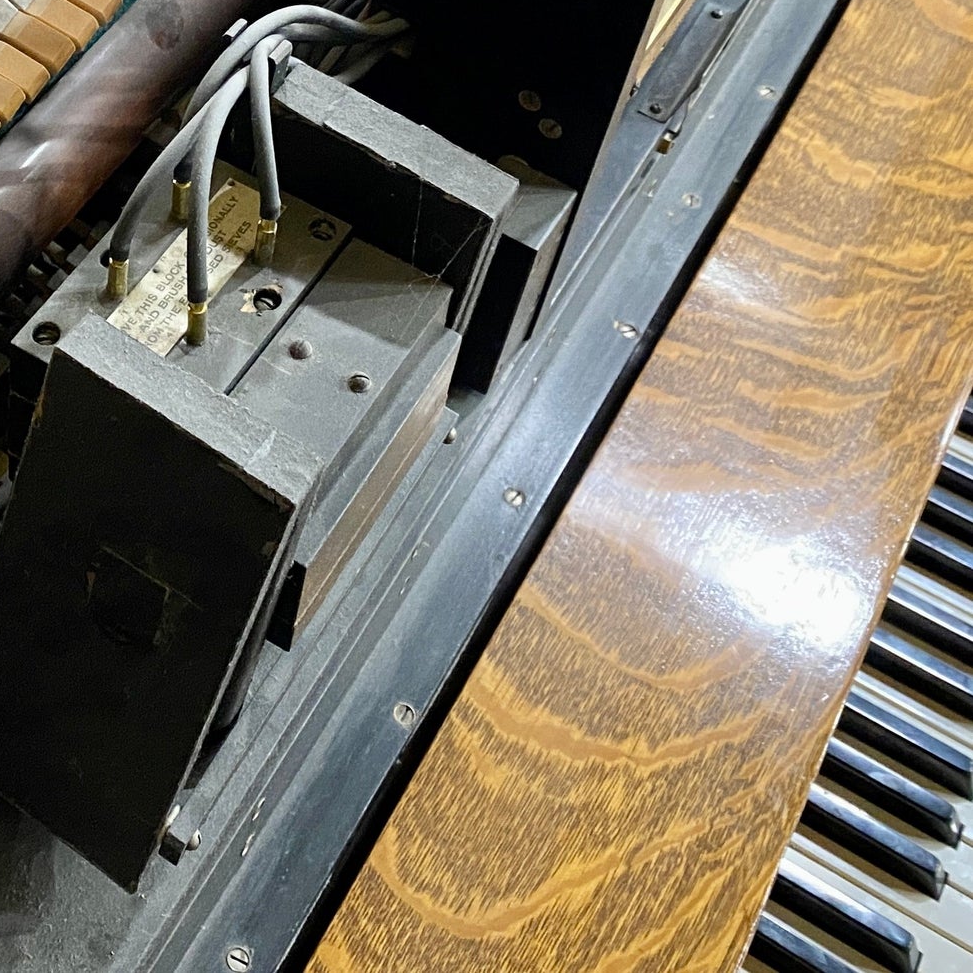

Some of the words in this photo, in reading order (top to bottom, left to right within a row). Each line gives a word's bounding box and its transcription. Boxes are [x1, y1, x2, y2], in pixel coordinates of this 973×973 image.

[135, 293, 158, 317] THIS
[156, 261, 185, 292] BLOCK
[139, 310, 160, 333] AND
[158, 276, 187, 308] BRUSH
[206, 230, 226, 255] DUST
[162, 307, 181, 326] THE
[221, 220, 251, 253] SIEVES
